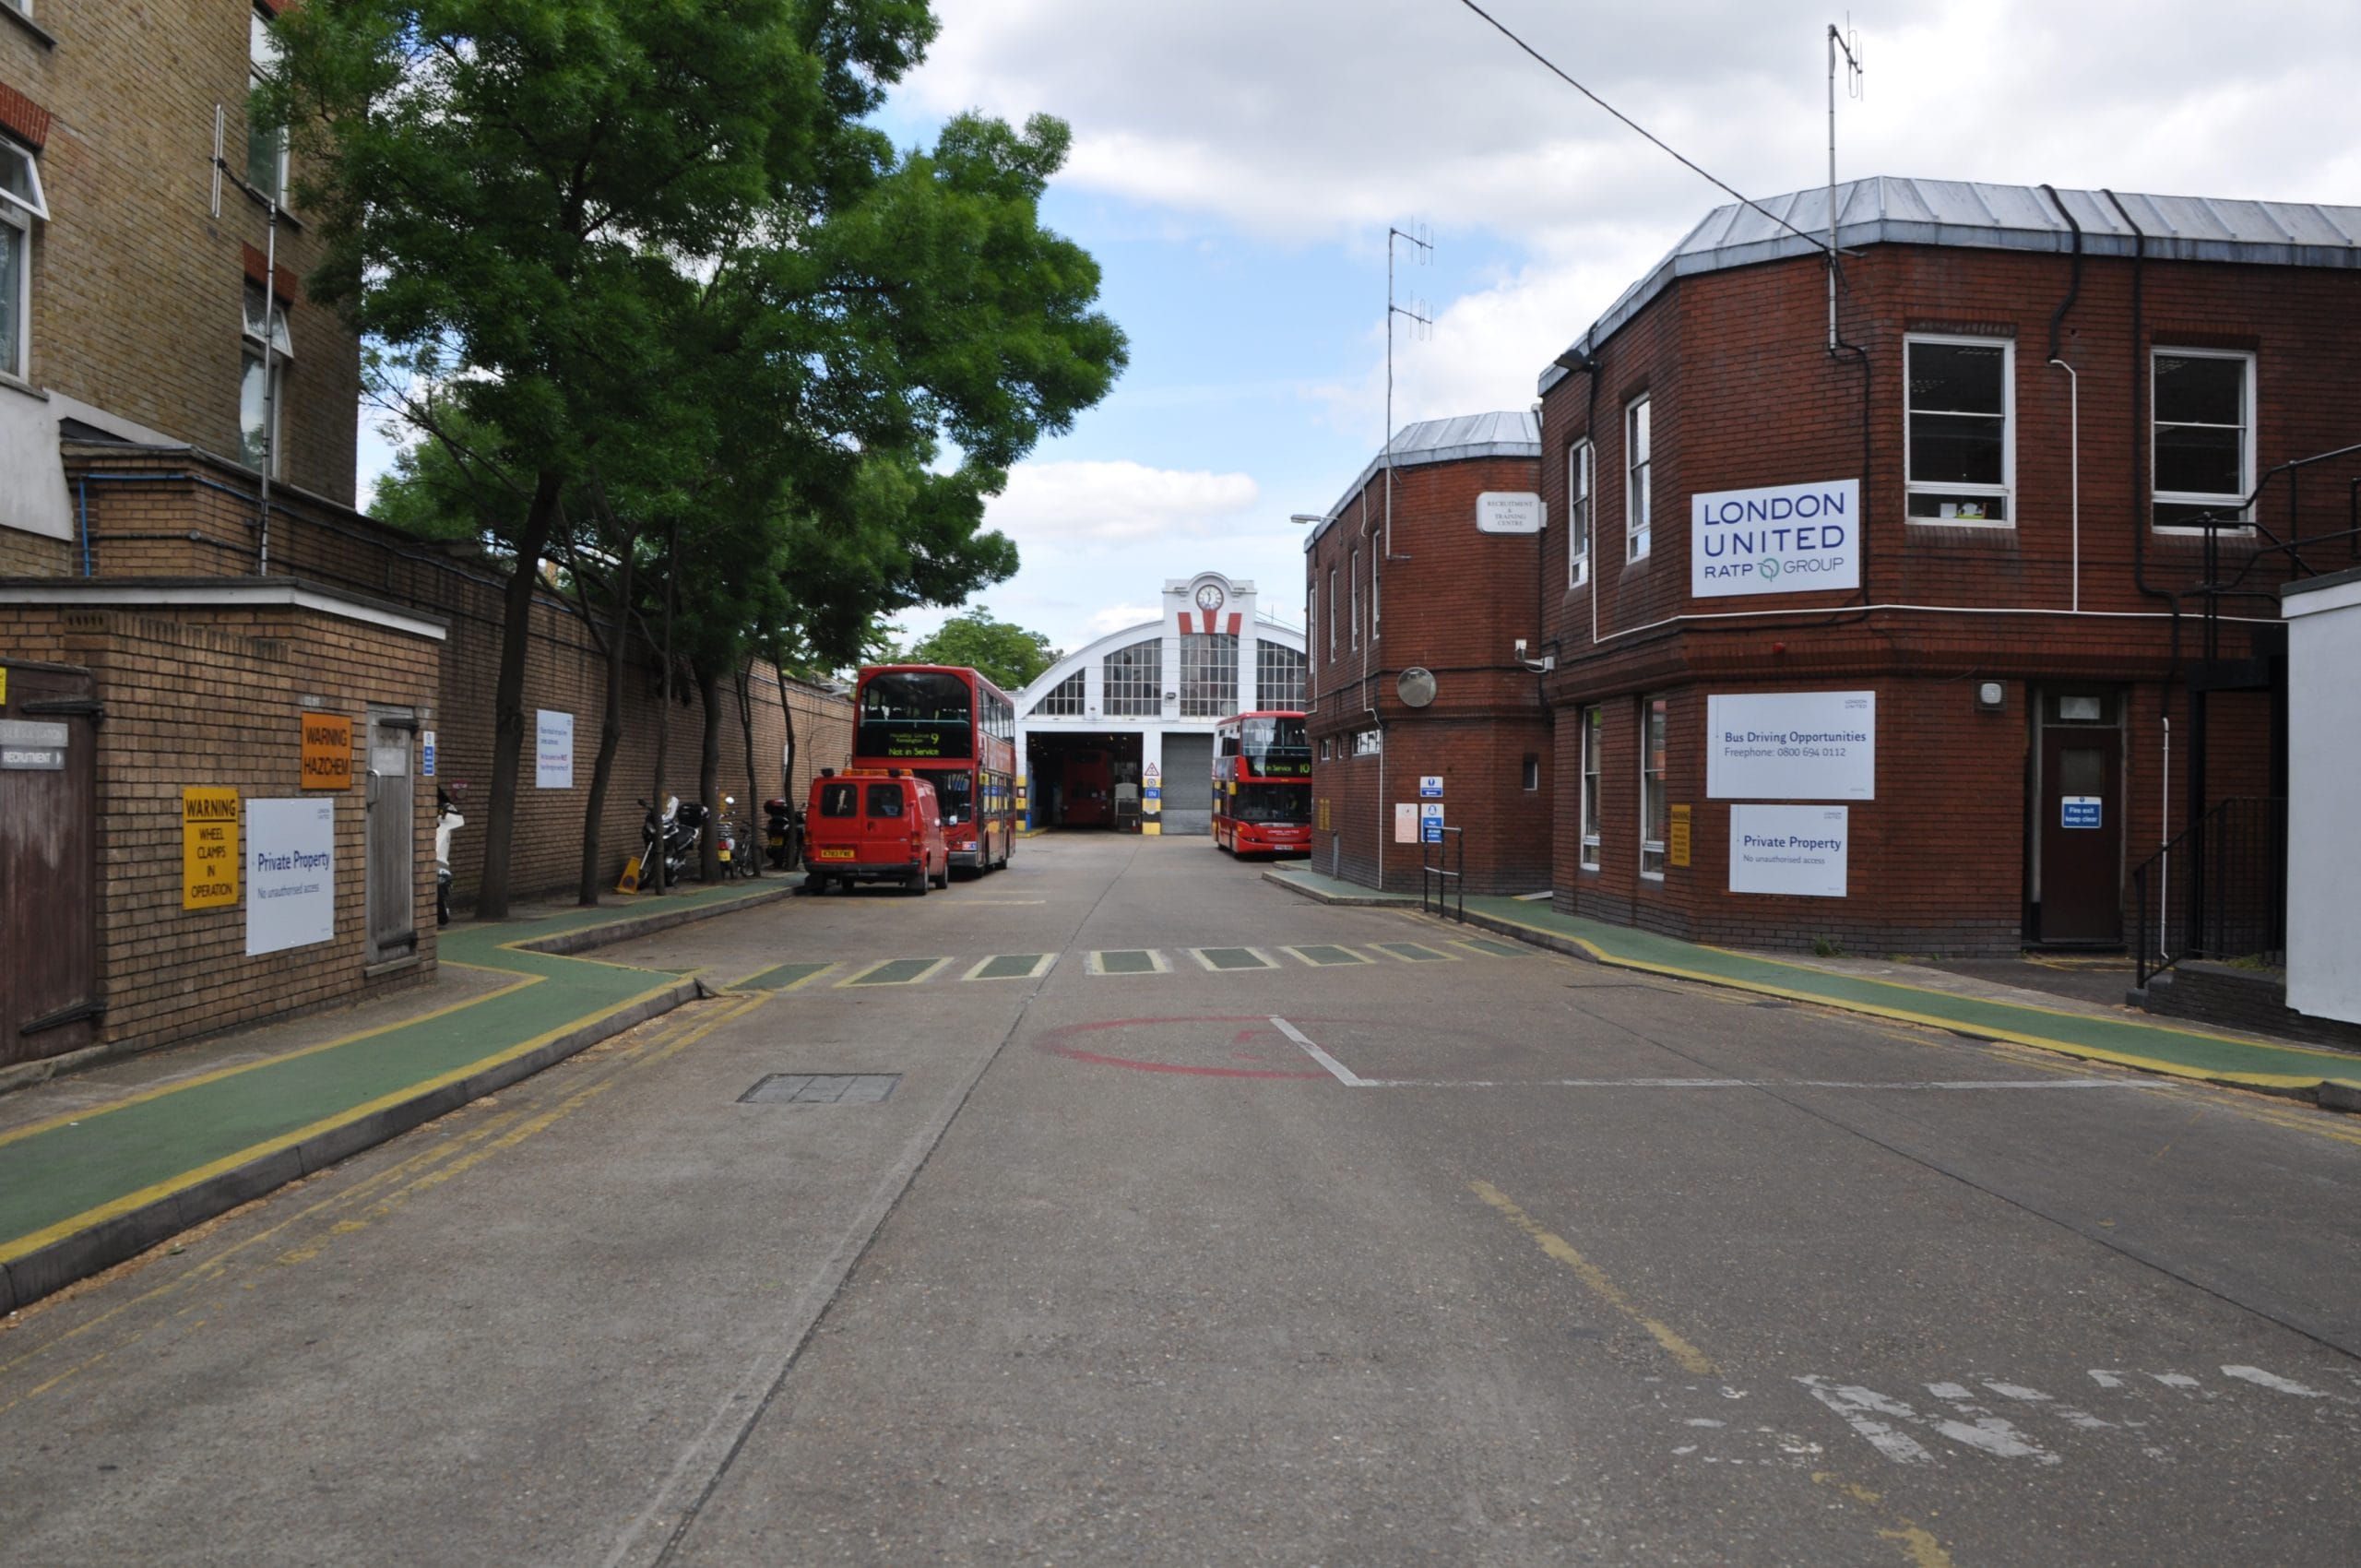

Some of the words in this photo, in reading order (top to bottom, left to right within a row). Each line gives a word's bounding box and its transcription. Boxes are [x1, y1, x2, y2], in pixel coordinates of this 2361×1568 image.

[1704, 493, 1845, 526] LONDON
[1704, 525, 1845, 557] UNITED
[1704, 564, 1754, 579] RATP
[1783, 556, 1845, 574] GROUP
[305, 726, 348, 747] WARNING
[931, 732, 939, 744] 9
[1725, 731, 1745, 742] Bus
[1747, 731, 1787, 745] Driving
[1789, 730, 1868, 745] Opportunities
[3, 752, 52, 764] RECRUITMENT
[1724, 747, 1776, 759] Freephone:
[1777, 747, 1800, 757] 0800
[1802, 747, 1821, 757] 694
[1821, 747, 1846, 757] 0112
[303, 755, 349, 776] HAZCHEM
[1299, 764, 1311, 774] 10
[186, 799, 236, 818] WARNING
[2069, 806, 2082, 814] Fire
[2082, 806, 2095, 814] exit
[2065, 815, 2081, 824] keep
[199, 827, 224, 841] WHEEL
[1743, 835, 1786, 848] Private
[1789, 836, 1842, 852] Property
[196, 846, 227, 860] CLAMPS
[1743, 854, 1754, 862] No
[1755, 854, 1801, 864] unauthorised
[258, 851, 291, 872] Private
[293, 850, 330, 872] Property
[207, 865, 216, 877] IN
[191, 883, 232, 898] OPERATION
[258, 887, 267, 899] No
[267, 883, 303, 898] unauthorised
[303, 883, 320, 894] access
